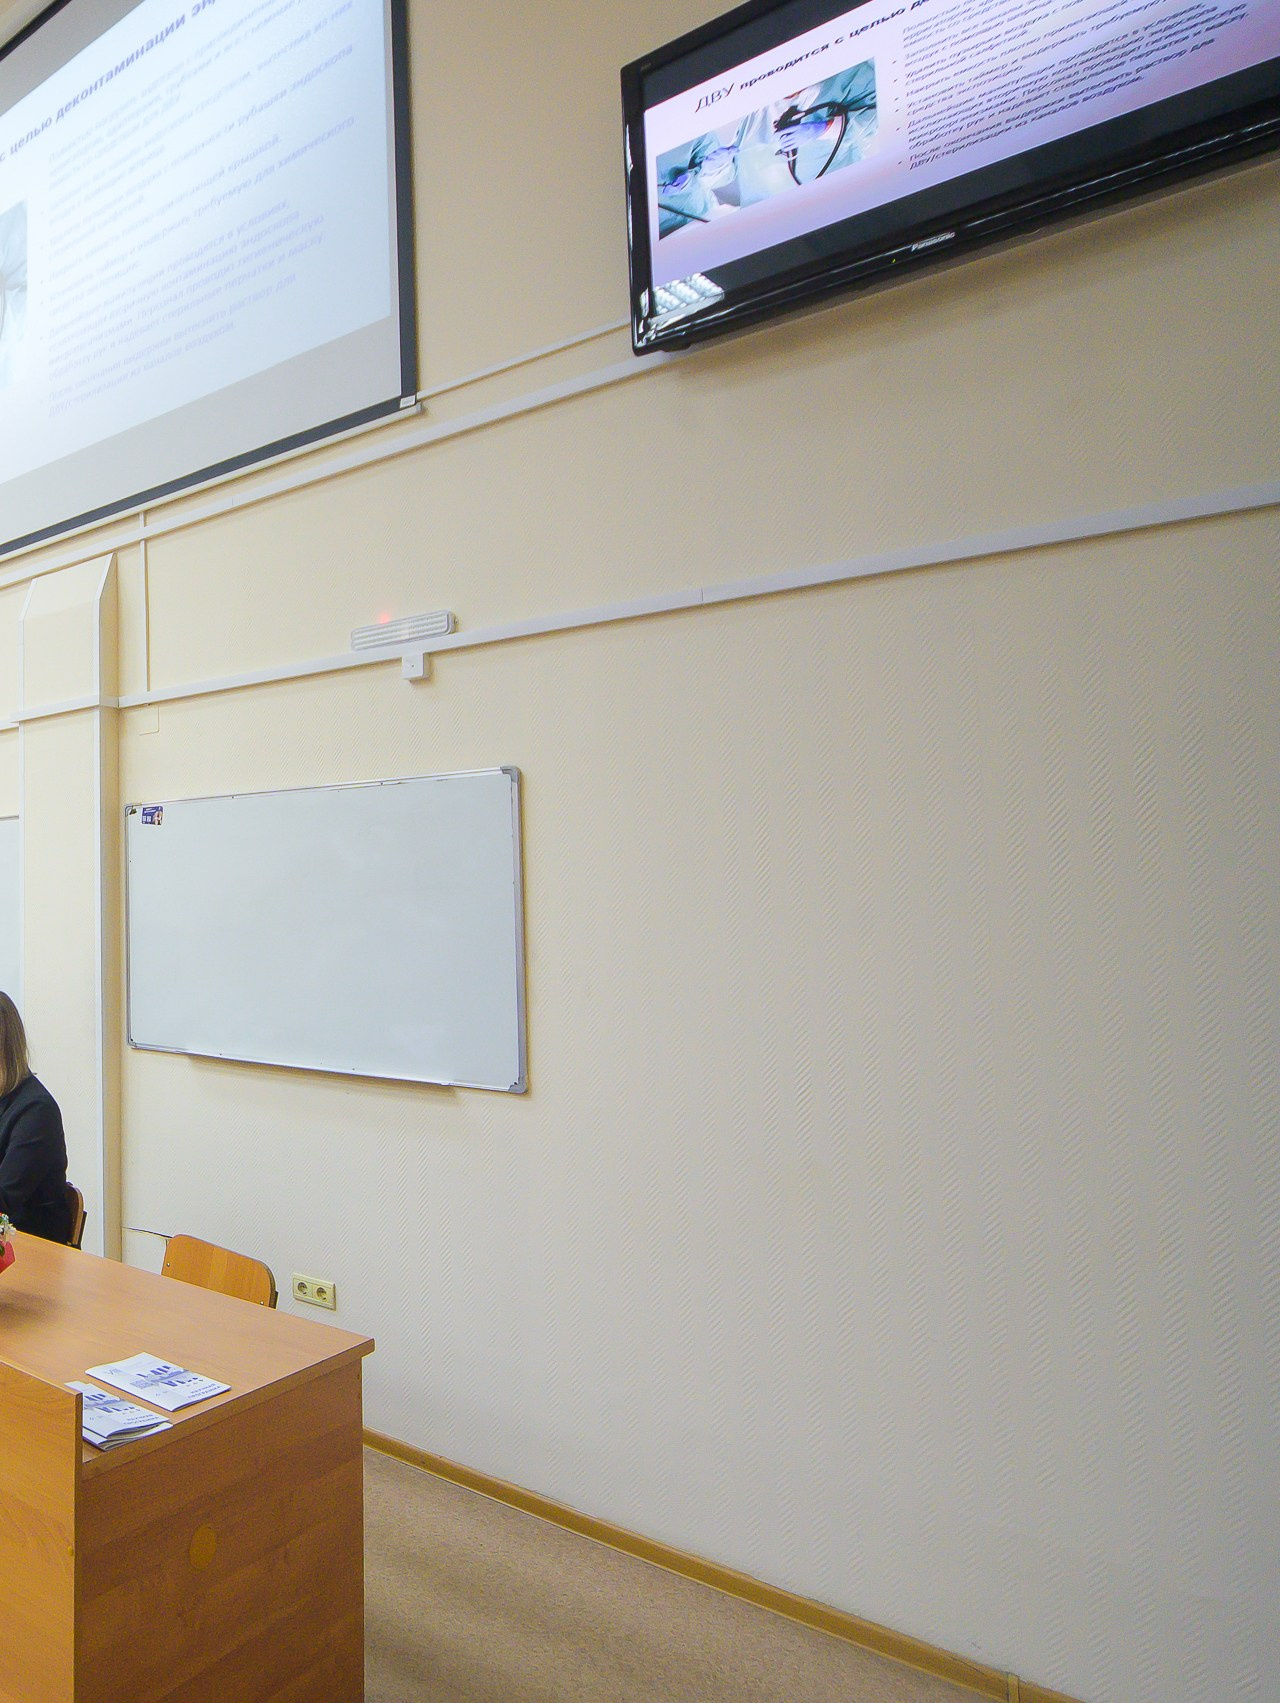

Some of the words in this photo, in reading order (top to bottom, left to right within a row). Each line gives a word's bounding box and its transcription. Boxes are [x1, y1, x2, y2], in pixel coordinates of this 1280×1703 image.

[9, 113, 52, 157] целью
[56, 10, 185, 123] деконтаминации
[739, 42, 829, 91] проводится
[849, 5, 905, 40] целью
